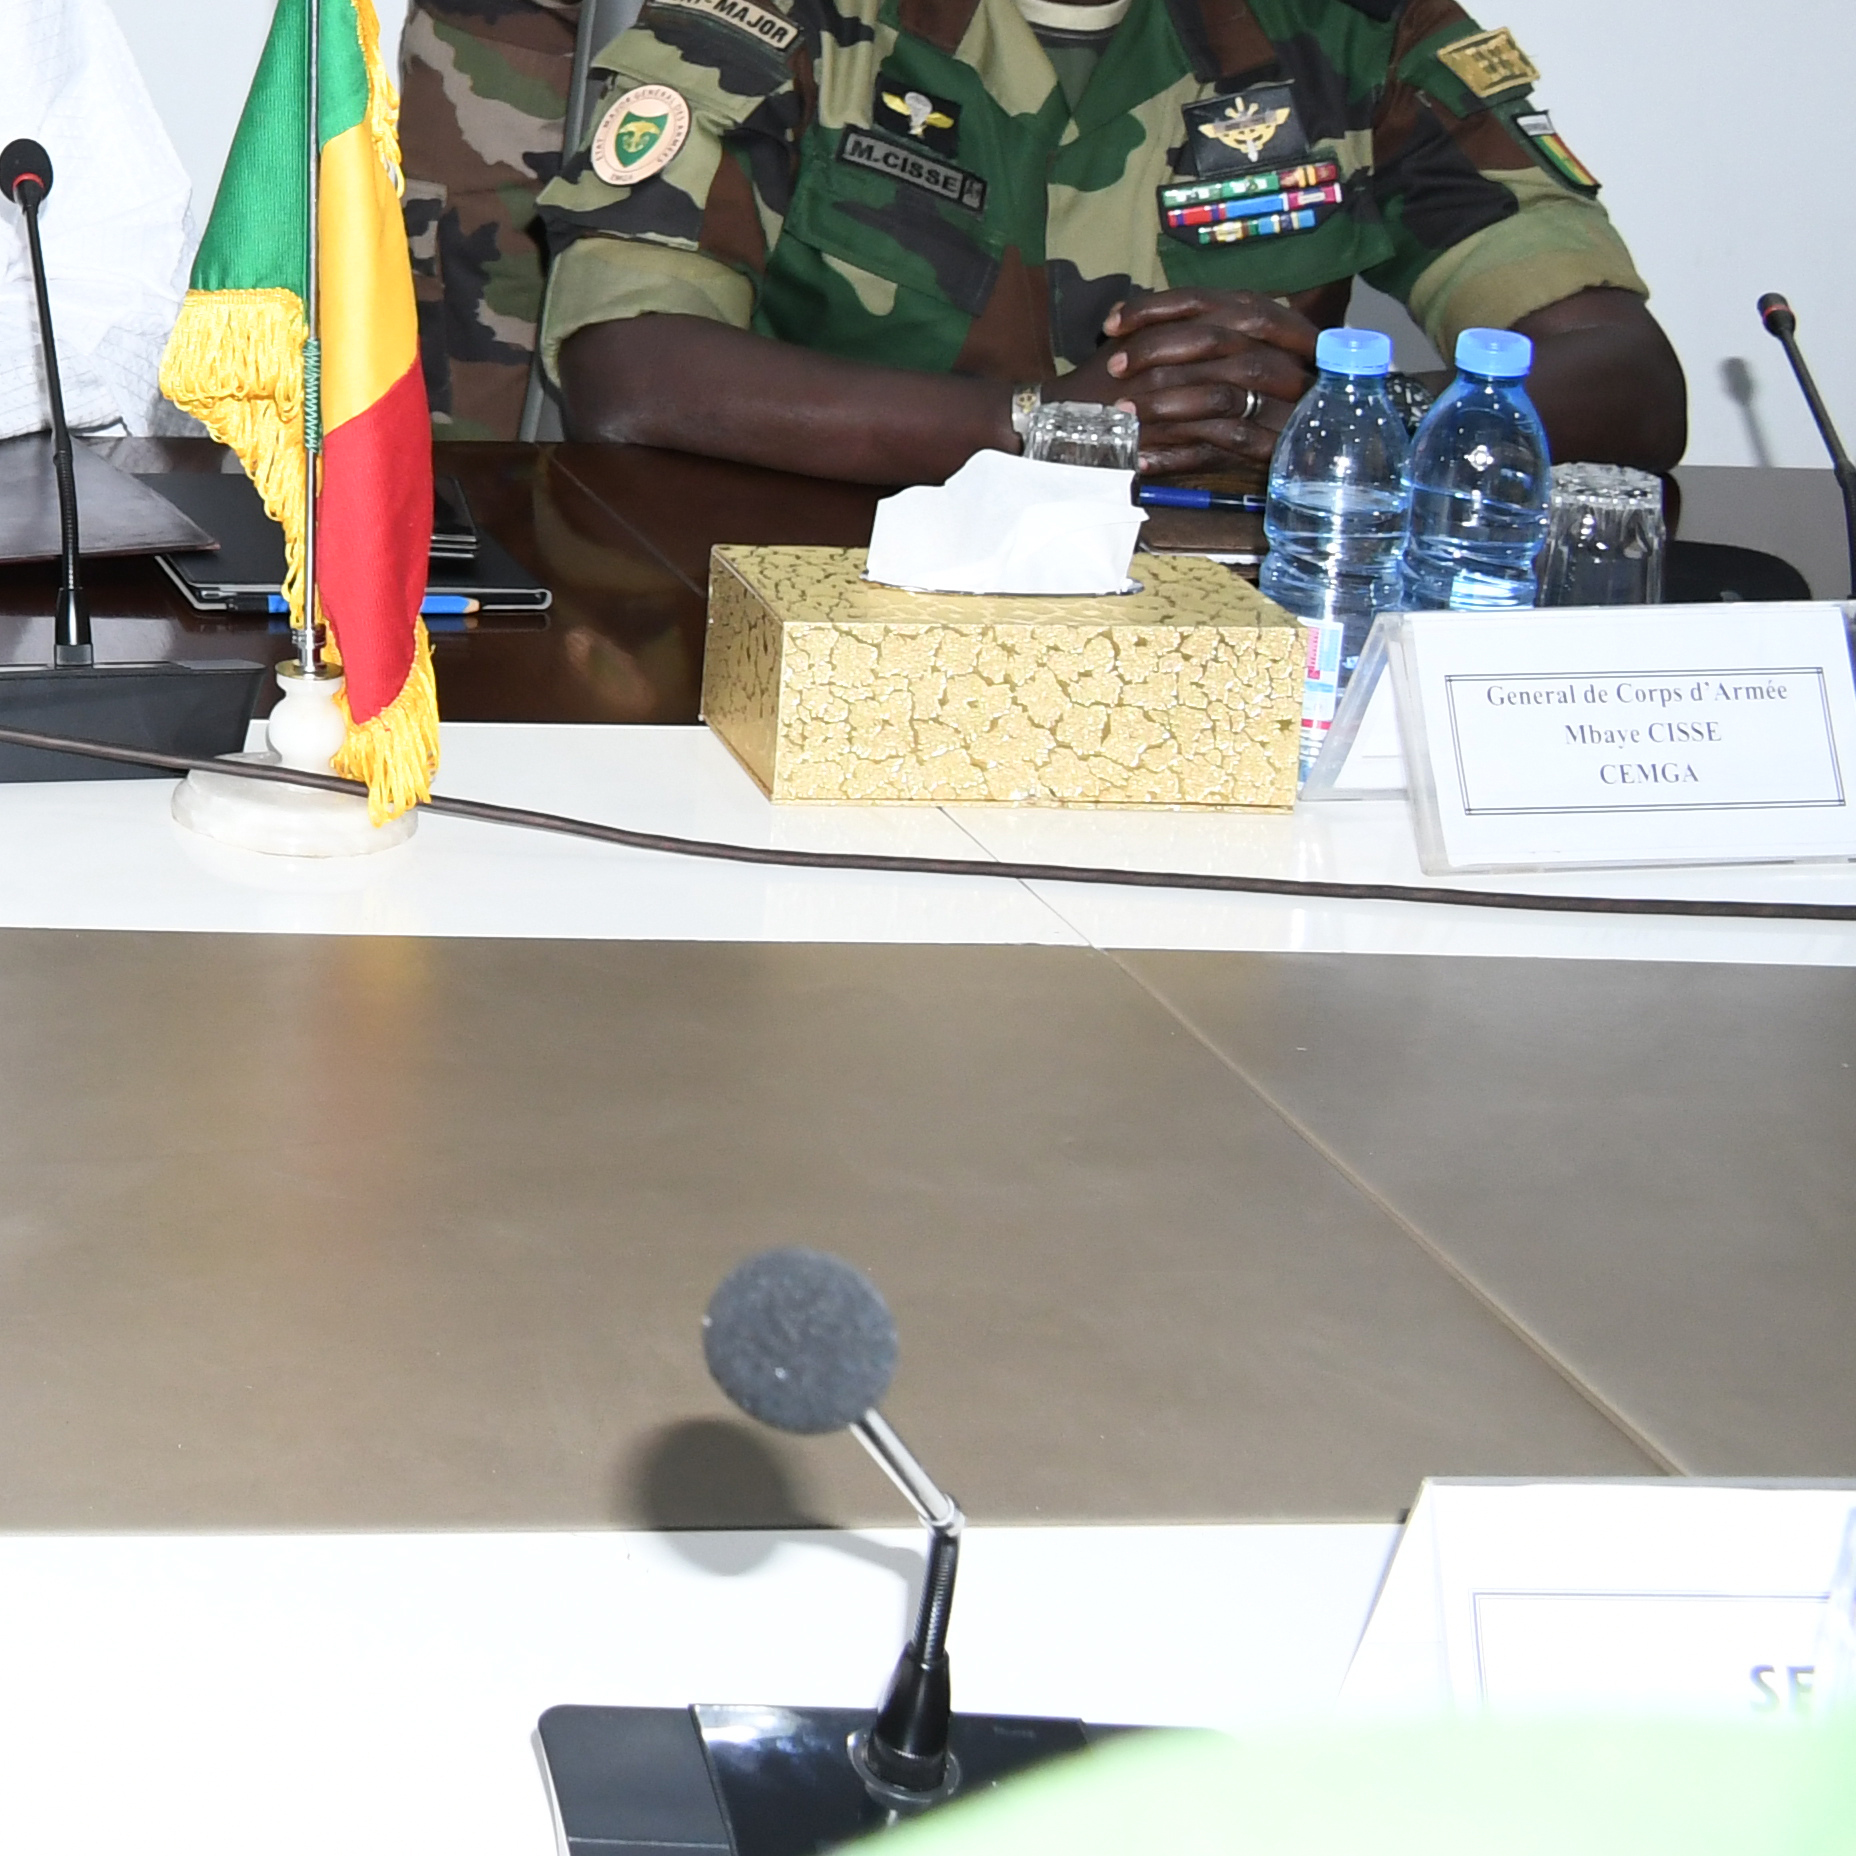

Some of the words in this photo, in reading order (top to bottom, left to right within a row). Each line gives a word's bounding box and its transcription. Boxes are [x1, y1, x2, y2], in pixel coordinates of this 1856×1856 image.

[1487, 684, 1577, 707] General
[1583, 683, 1610, 704] de
[1615, 682, 1684, 709] Corps
[1564, 724, 1641, 750] Mbaye
[1647, 720, 1723, 744] CISSE
[1599, 763, 1700, 785] CEMGA
